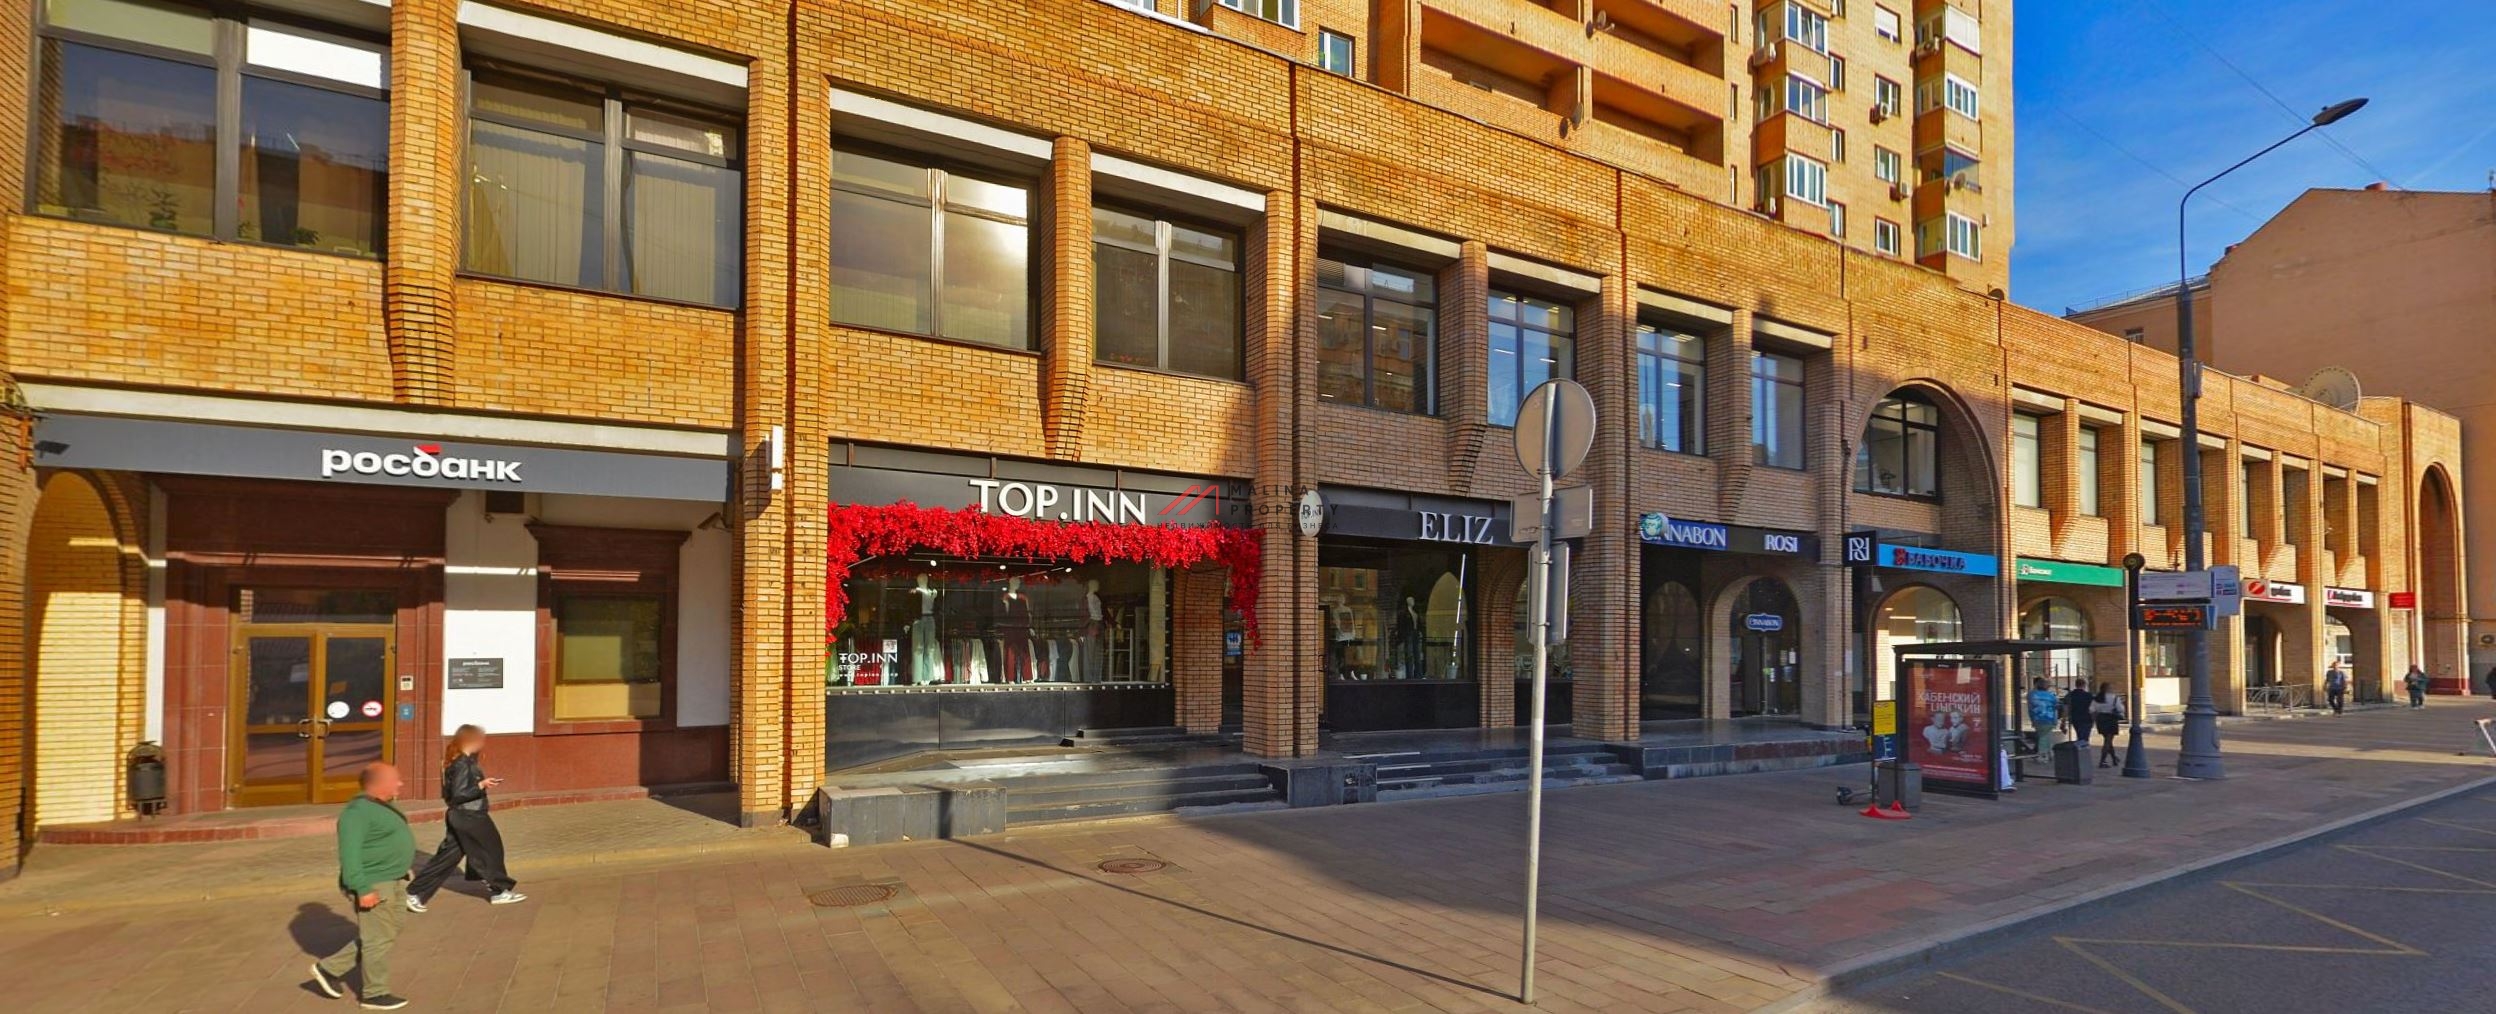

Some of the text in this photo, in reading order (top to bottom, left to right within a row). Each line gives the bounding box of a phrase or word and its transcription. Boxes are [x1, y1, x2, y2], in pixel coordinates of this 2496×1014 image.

[321, 443, 523, 482] росбанк
[968, 478, 1146, 525] TOP.INN
[1419, 511, 1494, 545] ELIZ
[1764, 534, 1799, 553] ROSI
[838, 652, 898, 664] TOP.INN
